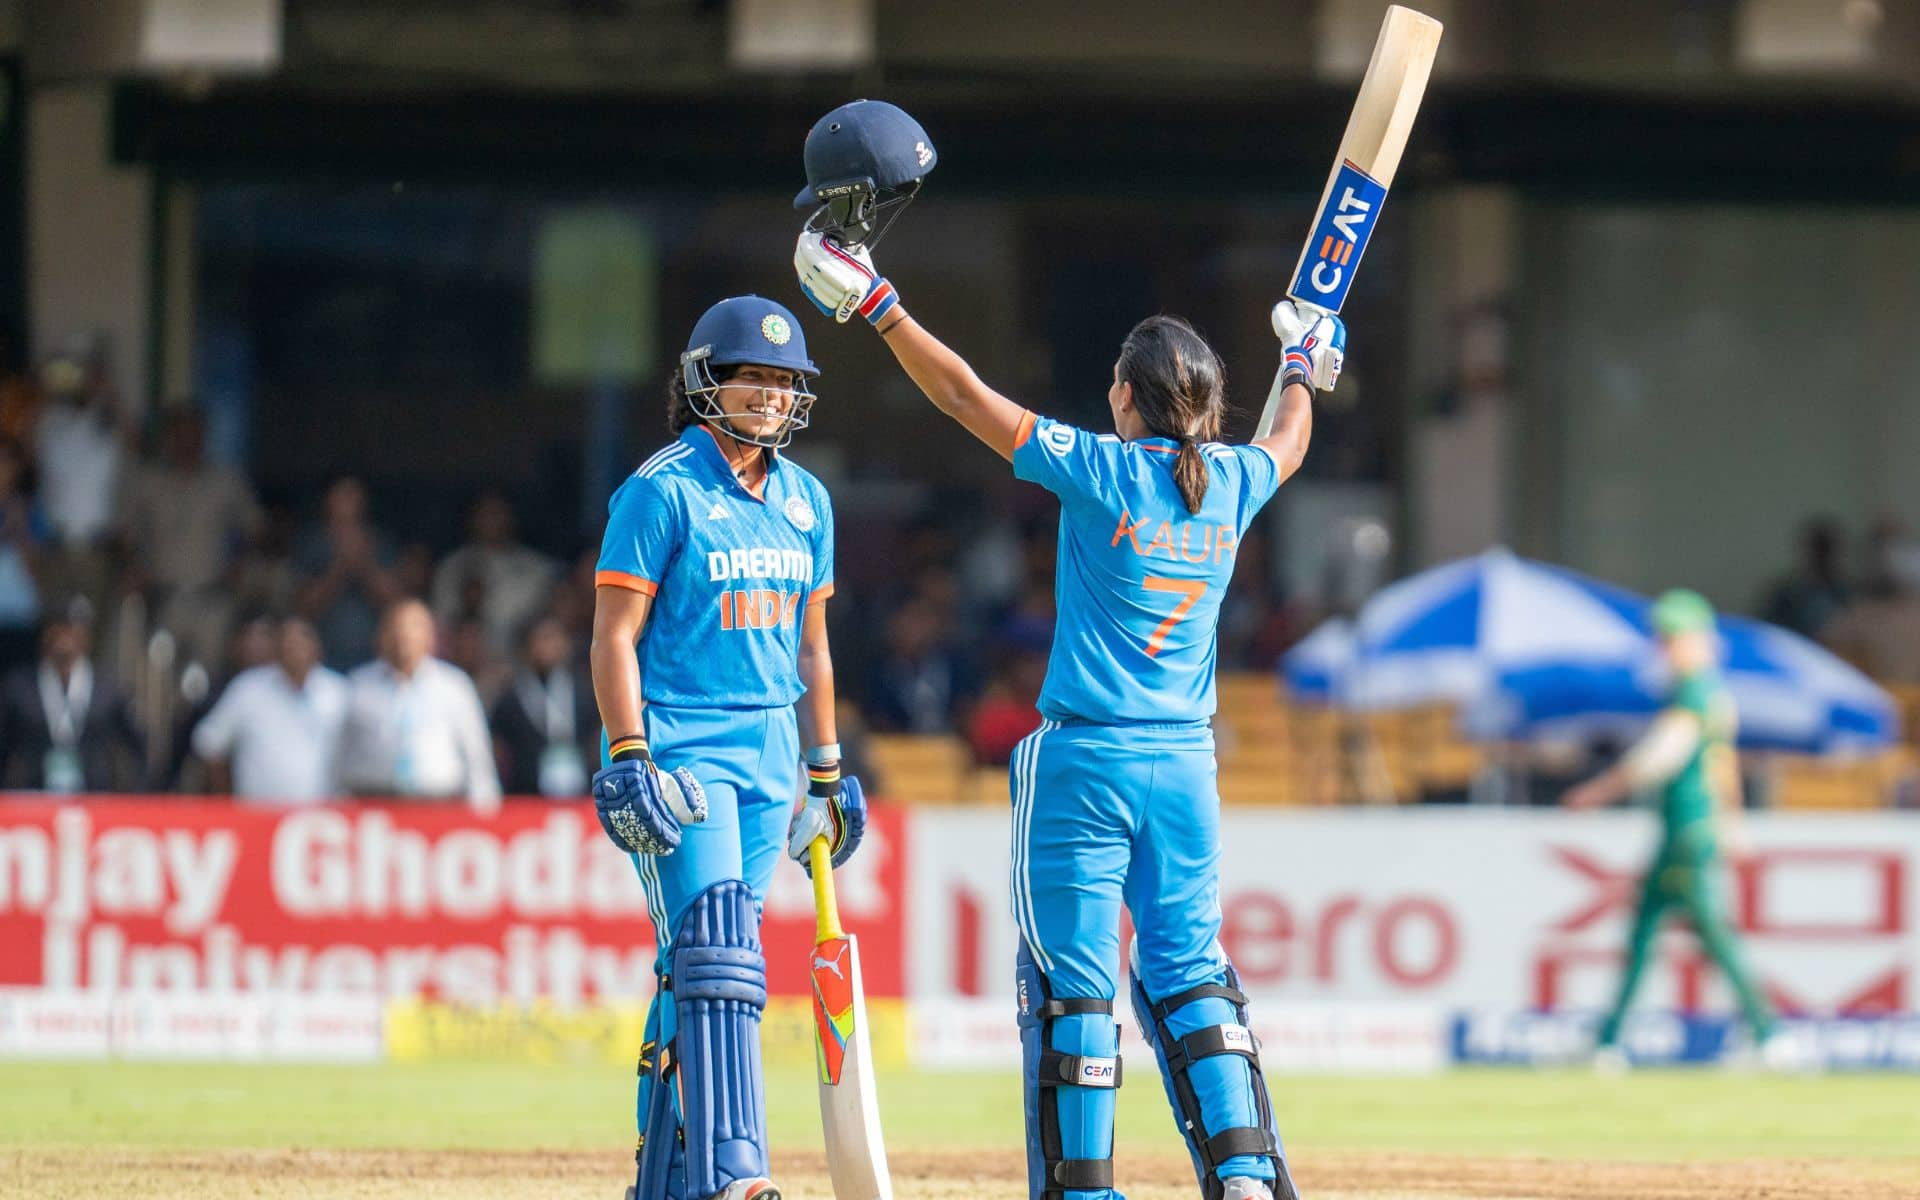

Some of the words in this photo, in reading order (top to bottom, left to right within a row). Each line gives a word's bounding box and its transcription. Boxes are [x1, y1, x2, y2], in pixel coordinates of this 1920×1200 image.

[1311, 186, 1371, 294] CEAT
[1111, 510, 1238, 565] KAUR
[1142, 576, 1208, 658] 7
[1084, 1064, 1114, 1078] CEAT
